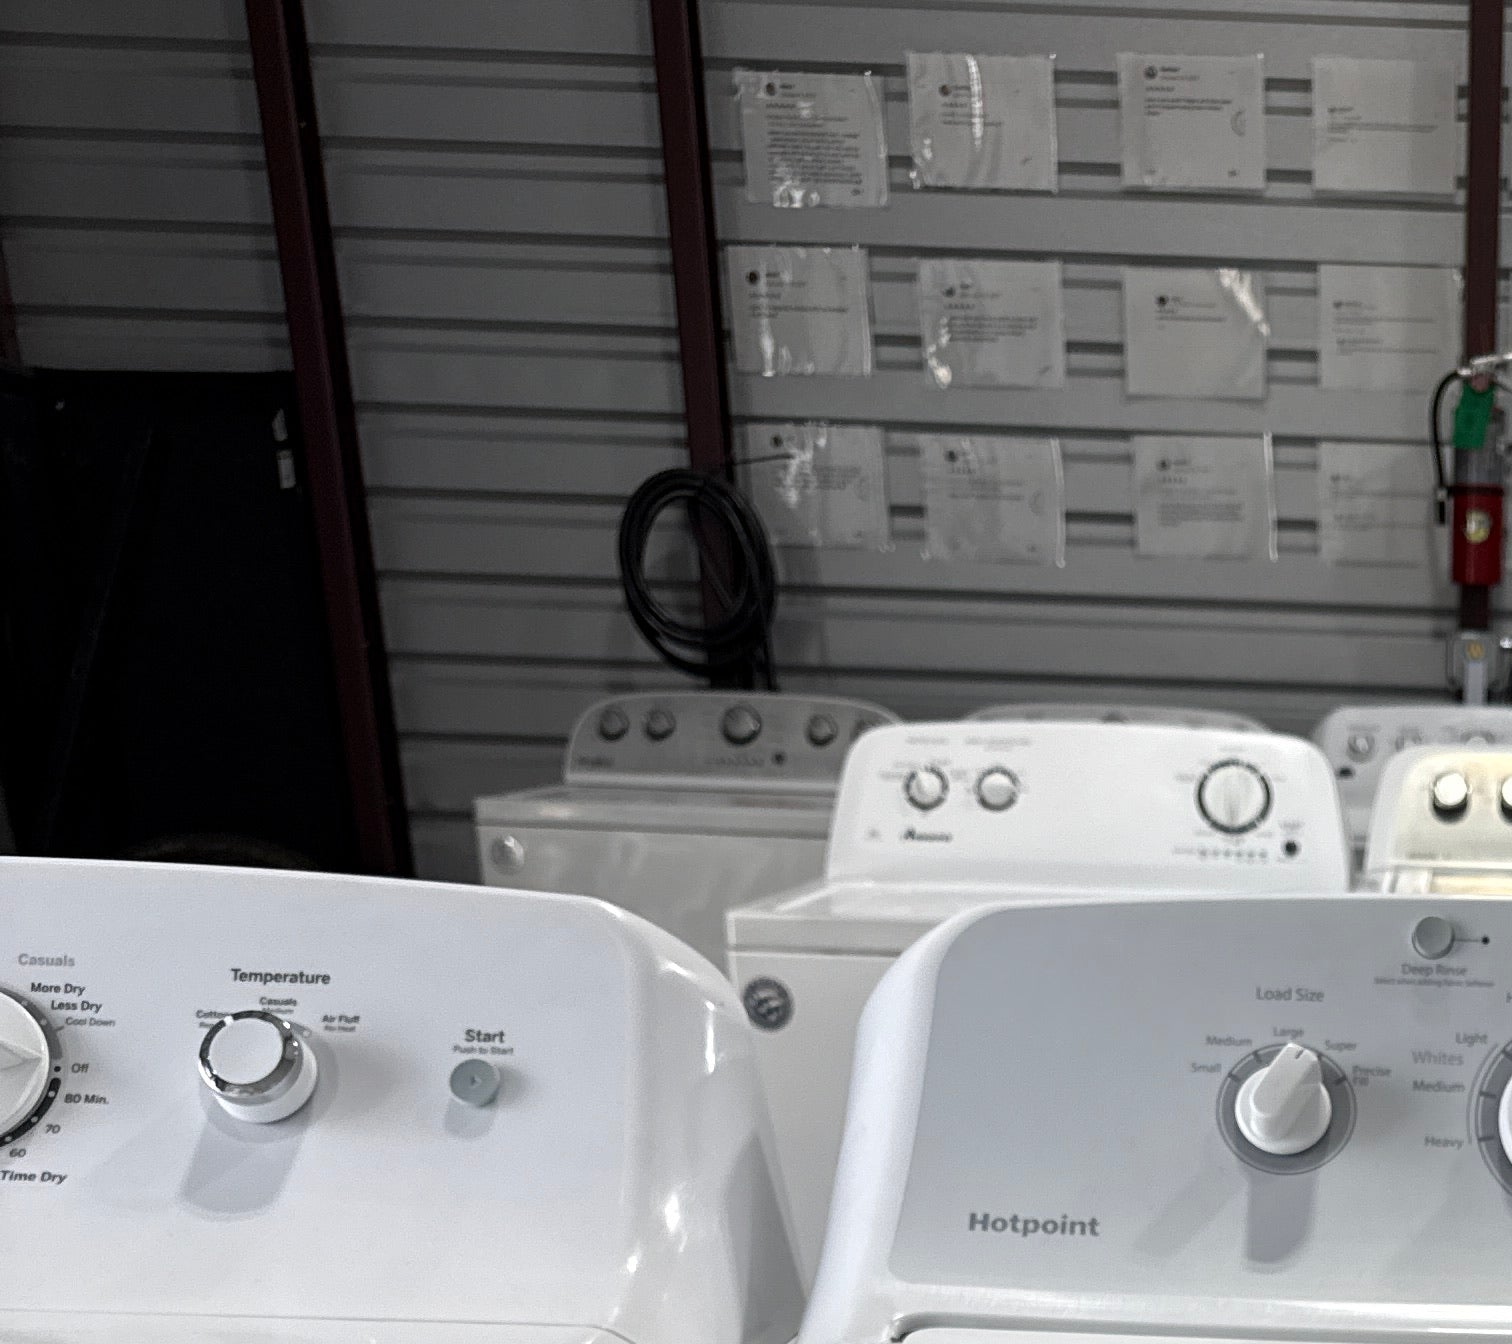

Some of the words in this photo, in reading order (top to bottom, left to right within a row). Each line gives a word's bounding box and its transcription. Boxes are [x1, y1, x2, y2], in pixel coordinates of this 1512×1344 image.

[18, 953, 75, 967] Casuals
[231, 968, 331, 985] Temperature
[1401, 964, 1434, 977] Deep
[1436, 964, 1468, 976] Rinse
[30, 982, 61, 993] More
[64, 983, 86, 997] Dry
[1256, 986, 1292, 1001] Load
[1295, 987, 1325, 1002] Size
[51, 1000, 77, 1011] Less
[80, 1001, 103, 1014] Dry
[464, 1028, 505, 1043] Start
[1273, 1026, 1305, 1040] Large
[1455, 1032, 1488, 1046] Light
[1206, 1036, 1252, 1047] Medium
[1325, 1039, 1357, 1051] Super
[1411, 1050, 1465, 1066] Whites
[71, 1063, 90, 1074] Off
[1191, 1063, 1222, 1073] Small
[1412, 1080, 1466, 1093] Medium
[45, 1124, 61, 1135] 70
[1424, 1136, 1465, 1151] Heavy
[9, 1148, 27, 1158] 60
[0, 1170, 37, 1182] Time
[41, 1171, 68, 1185] Dry
[969, 1212, 1100, 1237] Hotpoint
